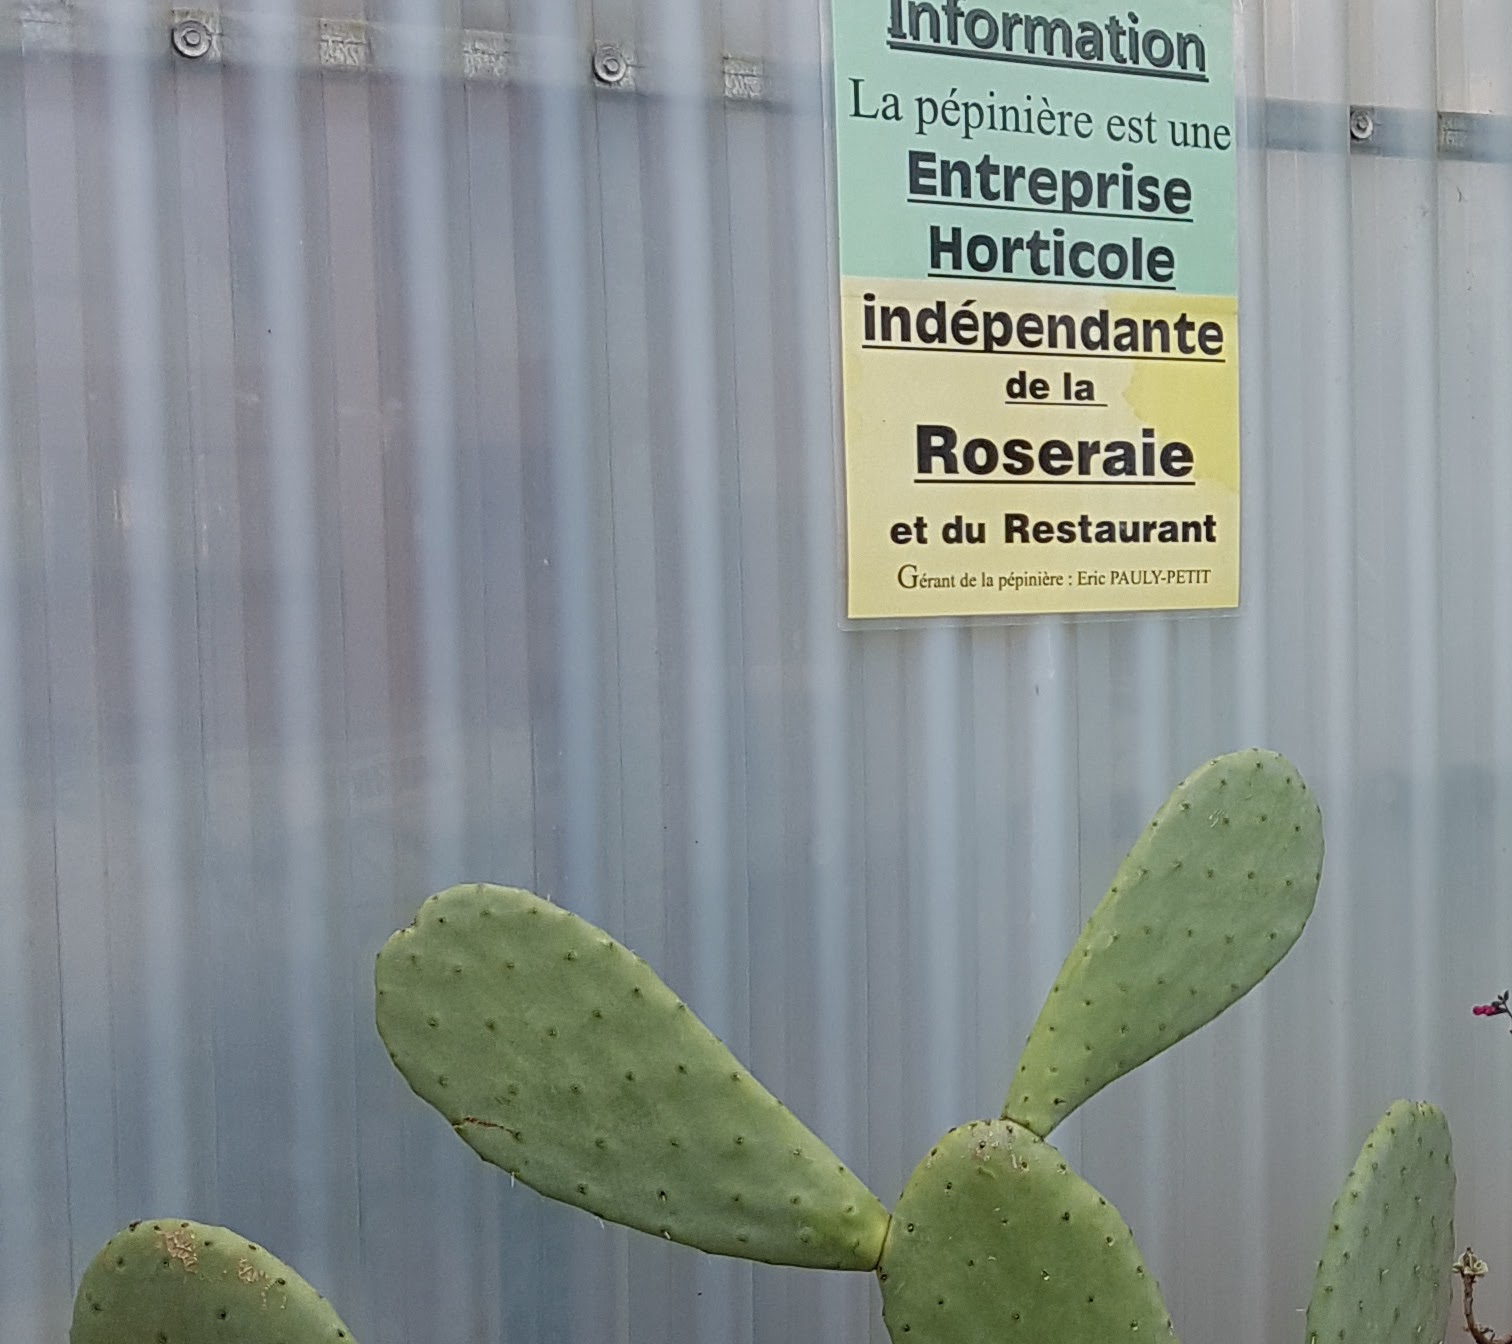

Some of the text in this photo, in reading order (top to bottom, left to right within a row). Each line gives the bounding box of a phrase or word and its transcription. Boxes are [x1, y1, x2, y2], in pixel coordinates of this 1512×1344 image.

[849, 77, 1232, 151] La pépinière est une
[908, 149, 1193, 213] Entreprise
[930, 225, 1175, 283] Horticole
[863, 292, 1224, 355] indépendante
[1005, 370, 1095, 401] de la
[916, 424, 1194, 478] Roseraie
[890, 513, 1217, 544] et du Restaurant
[897, 564, 955, 590] Gérant
[960, 572, 977, 589] de
[981, 570, 994, 588] la
[998, 570, 1063, 591] pépinière
[1077, 570, 1106, 587] Eric
[1110, 569, 1212, 586] PAULY-PETIT
